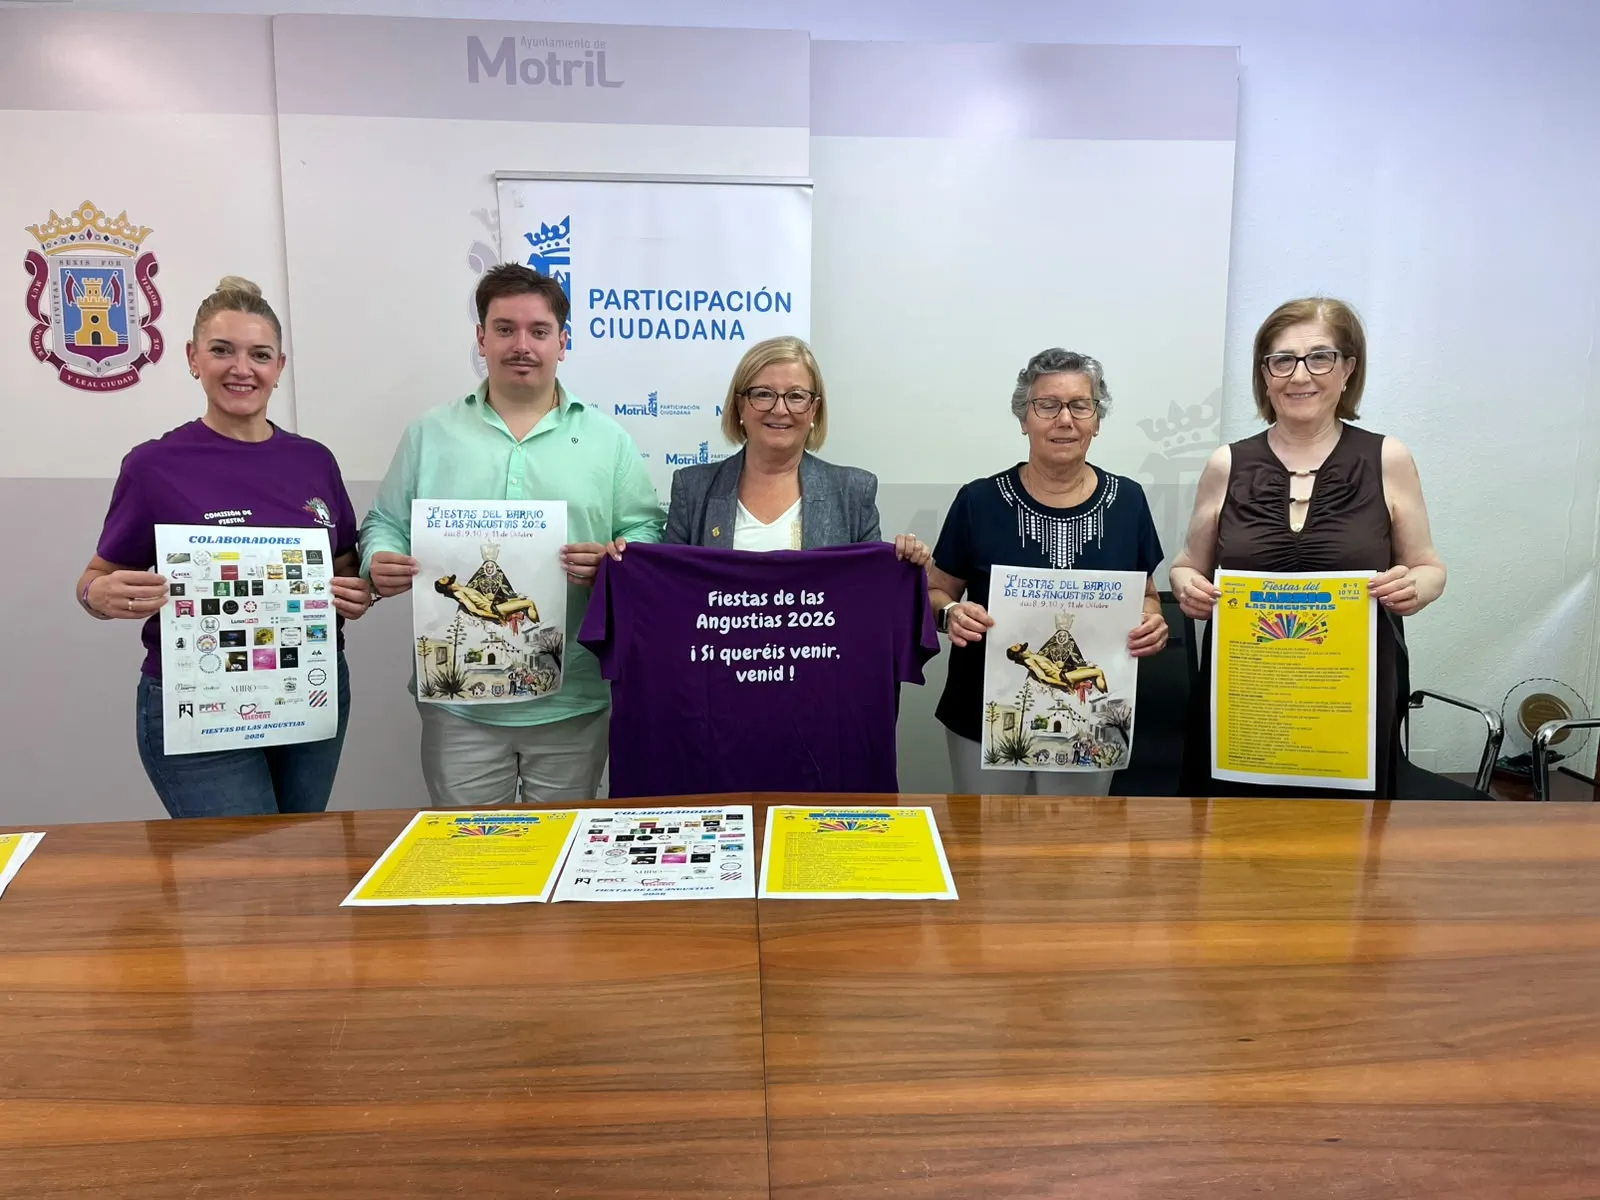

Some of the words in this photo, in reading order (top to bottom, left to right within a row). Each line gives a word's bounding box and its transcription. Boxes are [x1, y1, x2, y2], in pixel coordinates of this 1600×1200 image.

[521, 36, 590, 48] Ayuntamiento
[594, 40, 605, 49] de
[589, 286, 791, 313] PARTICIPACIÓN
[589, 317, 745, 341] CIUDADANA
[482, 509, 502, 519] DEL
[506, 509, 544, 519] BARRIO
[427, 519, 440, 528] DE
[522, 520, 546, 529] 2026
[189, 535, 301, 545] COLABORADORES
[1059, 580, 1079, 590] DEL
[1083, 580, 1122, 592] BARRIO
[1262, 580, 1301, 591] Fiestas
[1303, 581, 1321, 591] del
[708, 590, 768, 607] Fiestas
[773, 589, 795, 606] de
[800, 589, 825, 605] las
[1004, 589, 1018, 597] DE
[1022, 589, 1041, 599] LAS
[1099, 591, 1124, 601] 2026
[696, 612, 782, 635] Angustias
[787, 611, 836, 628] 2026
[701, 644, 715, 662] Si
[719, 643, 785, 666] queréis
[790, 643, 841, 660] venir,
[736, 665, 784, 683] venid
[201, 727, 234, 735] FIESTAS
[263, 720, 305, 730] ANGUSTIAS
